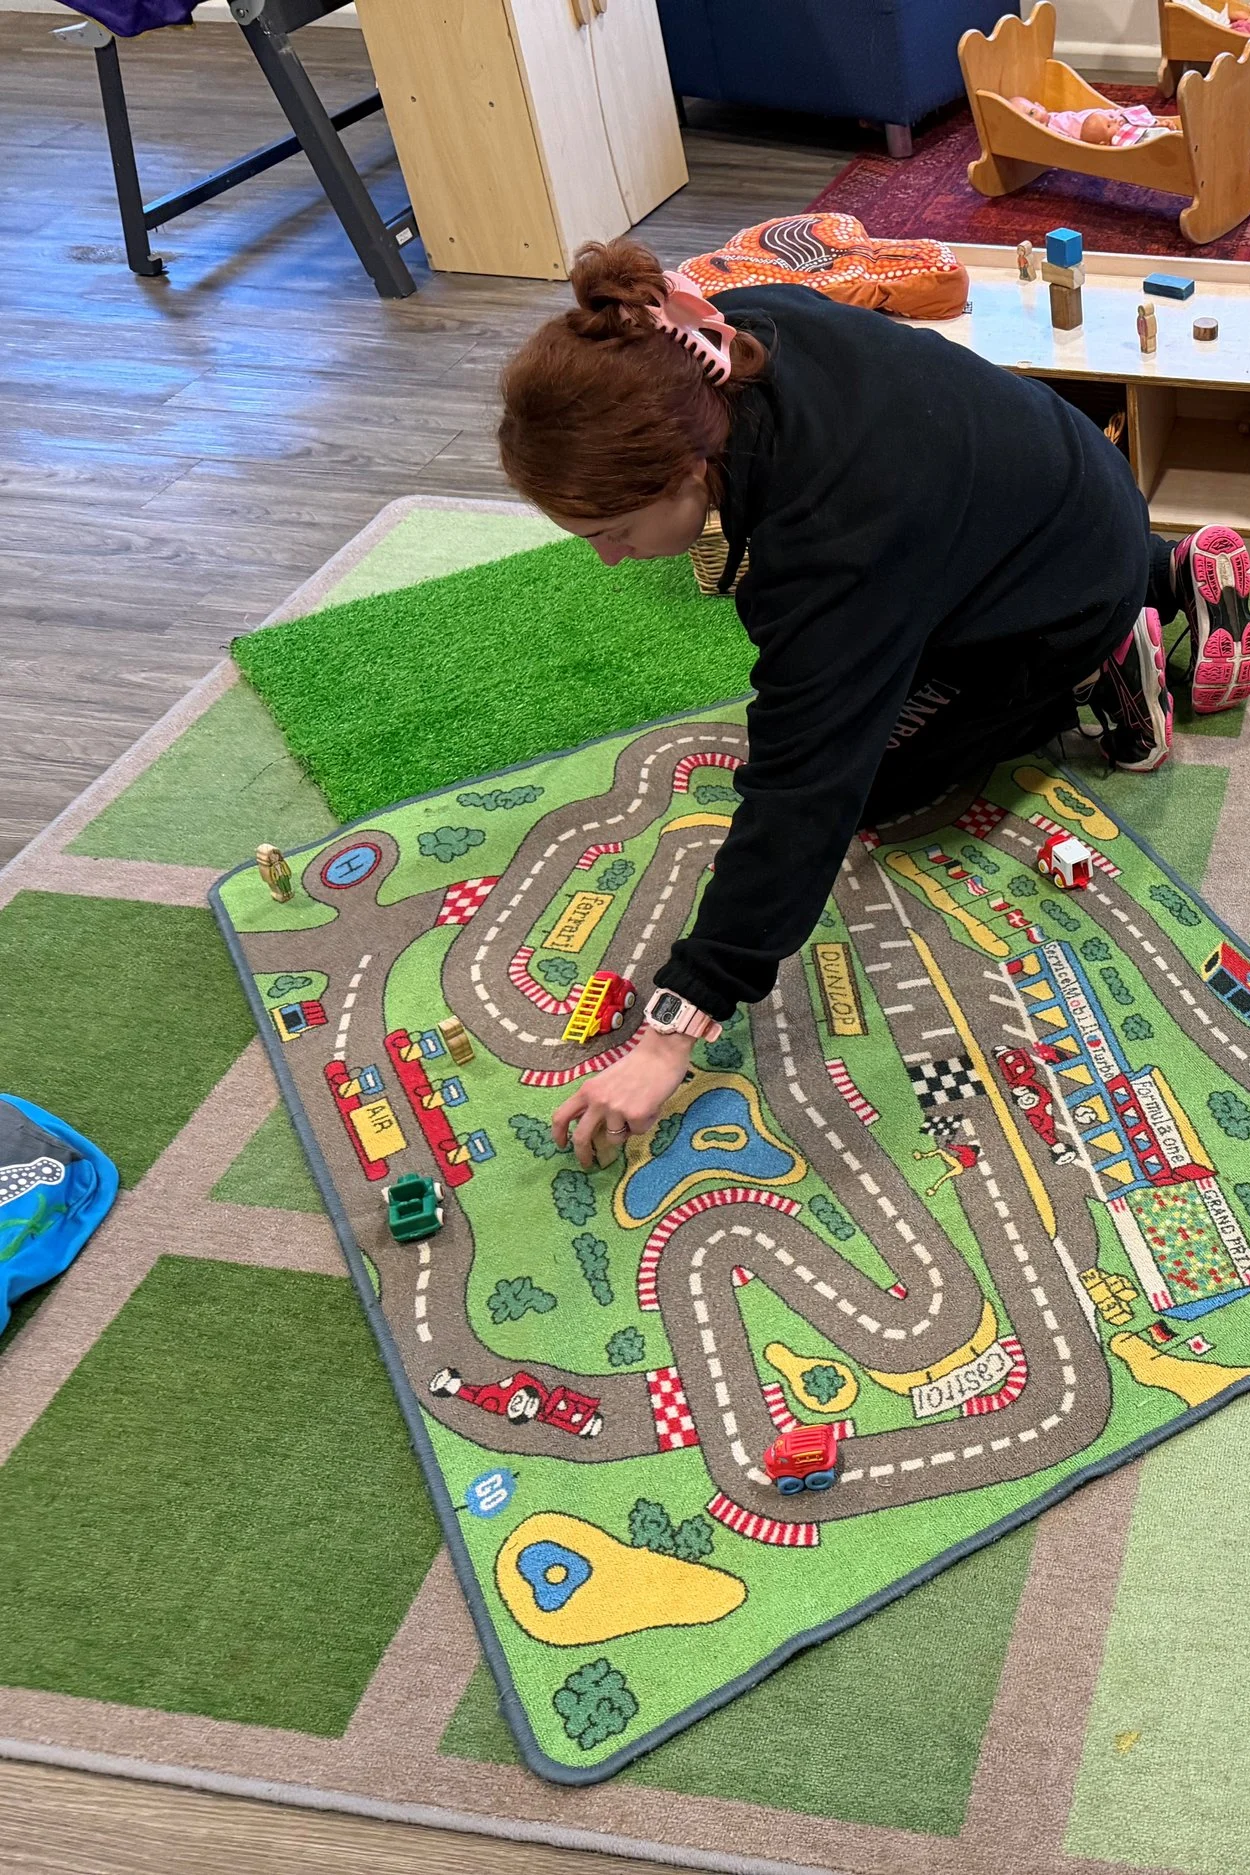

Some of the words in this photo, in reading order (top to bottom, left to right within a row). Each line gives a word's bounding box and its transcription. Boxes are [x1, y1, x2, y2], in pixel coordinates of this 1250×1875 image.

[335, 854, 364, 879] H
[550, 895, 605, 949] ferrari
[821, 950, 856, 1026] DUNLOP
[1043, 942, 1072, 984] Service
[1063, 985, 1098, 1034] Mobil
[1093, 1046, 1116, 1080] Turbo
[366, 1104, 394, 1135] AIR
[1162, 1136, 1185, 1165] one
[1202, 1189, 1236, 1241] GRAND
[916, 1352, 1006, 1410] Castrol
[474, 1473, 509, 1512] GO
